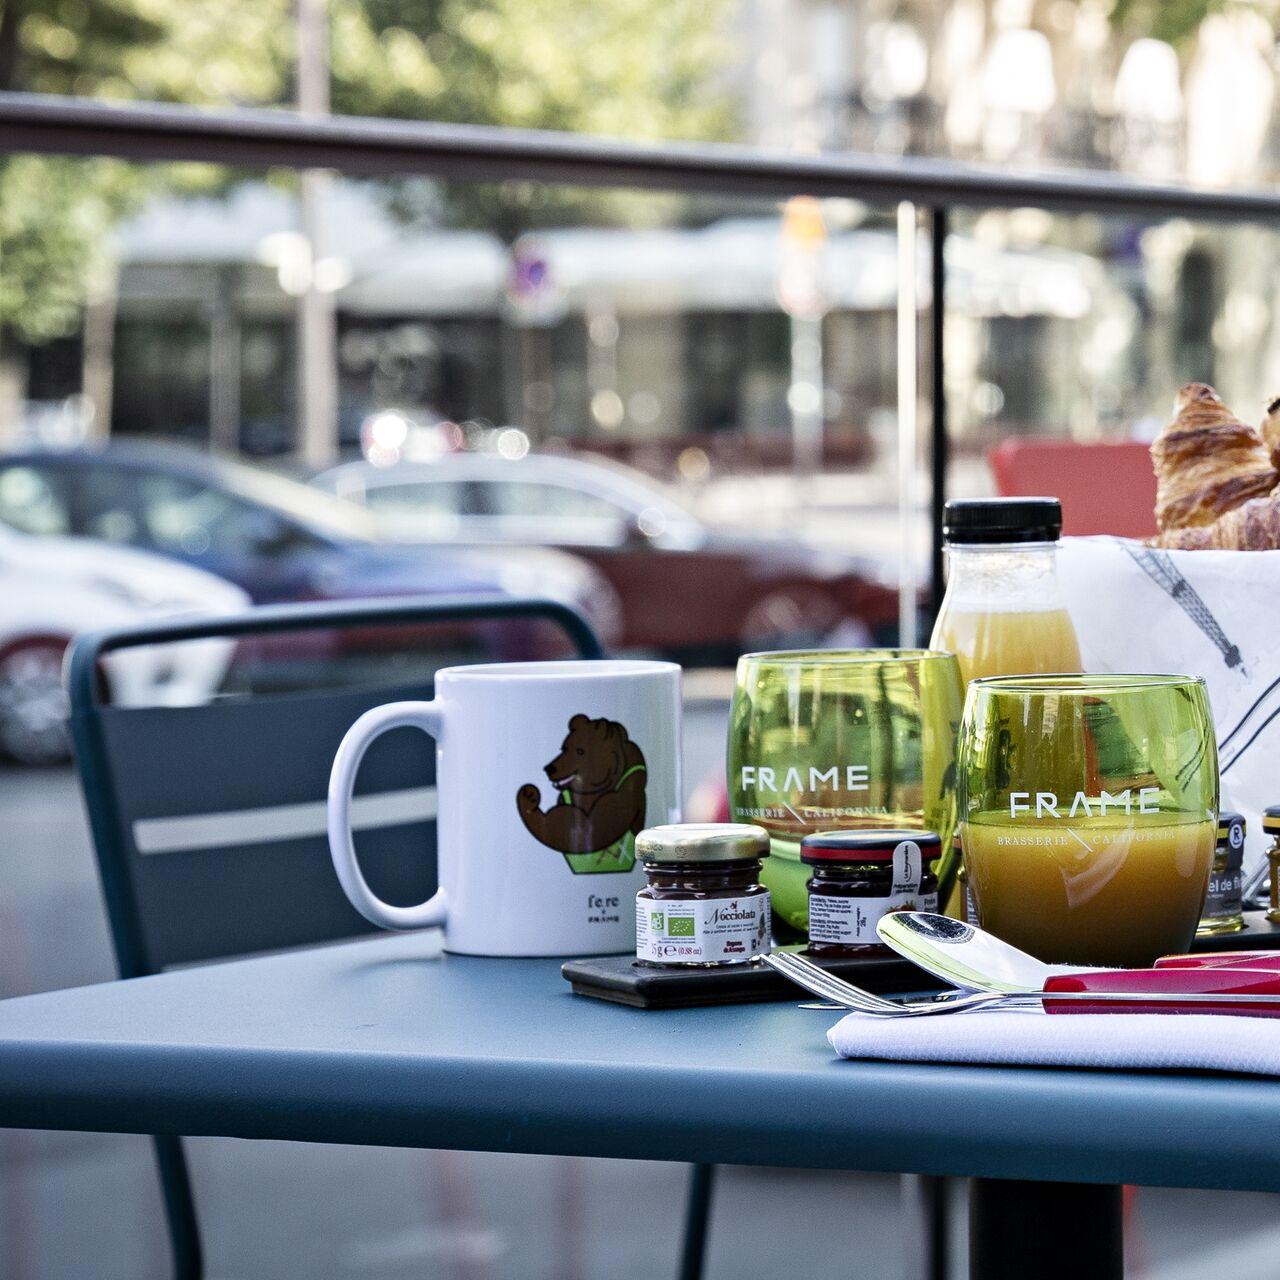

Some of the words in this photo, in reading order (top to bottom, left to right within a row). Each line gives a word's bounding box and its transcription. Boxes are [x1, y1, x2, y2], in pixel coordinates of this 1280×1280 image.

[741, 765, 869, 792] FRAME
[1009, 787, 1160, 819] FRAME
[804, 806, 888, 818] CALIFORNIA
[997, 836, 1068, 846] BRASSERIE
[1208, 880, 1219, 892] el
[1220, 878, 1232, 891] de
